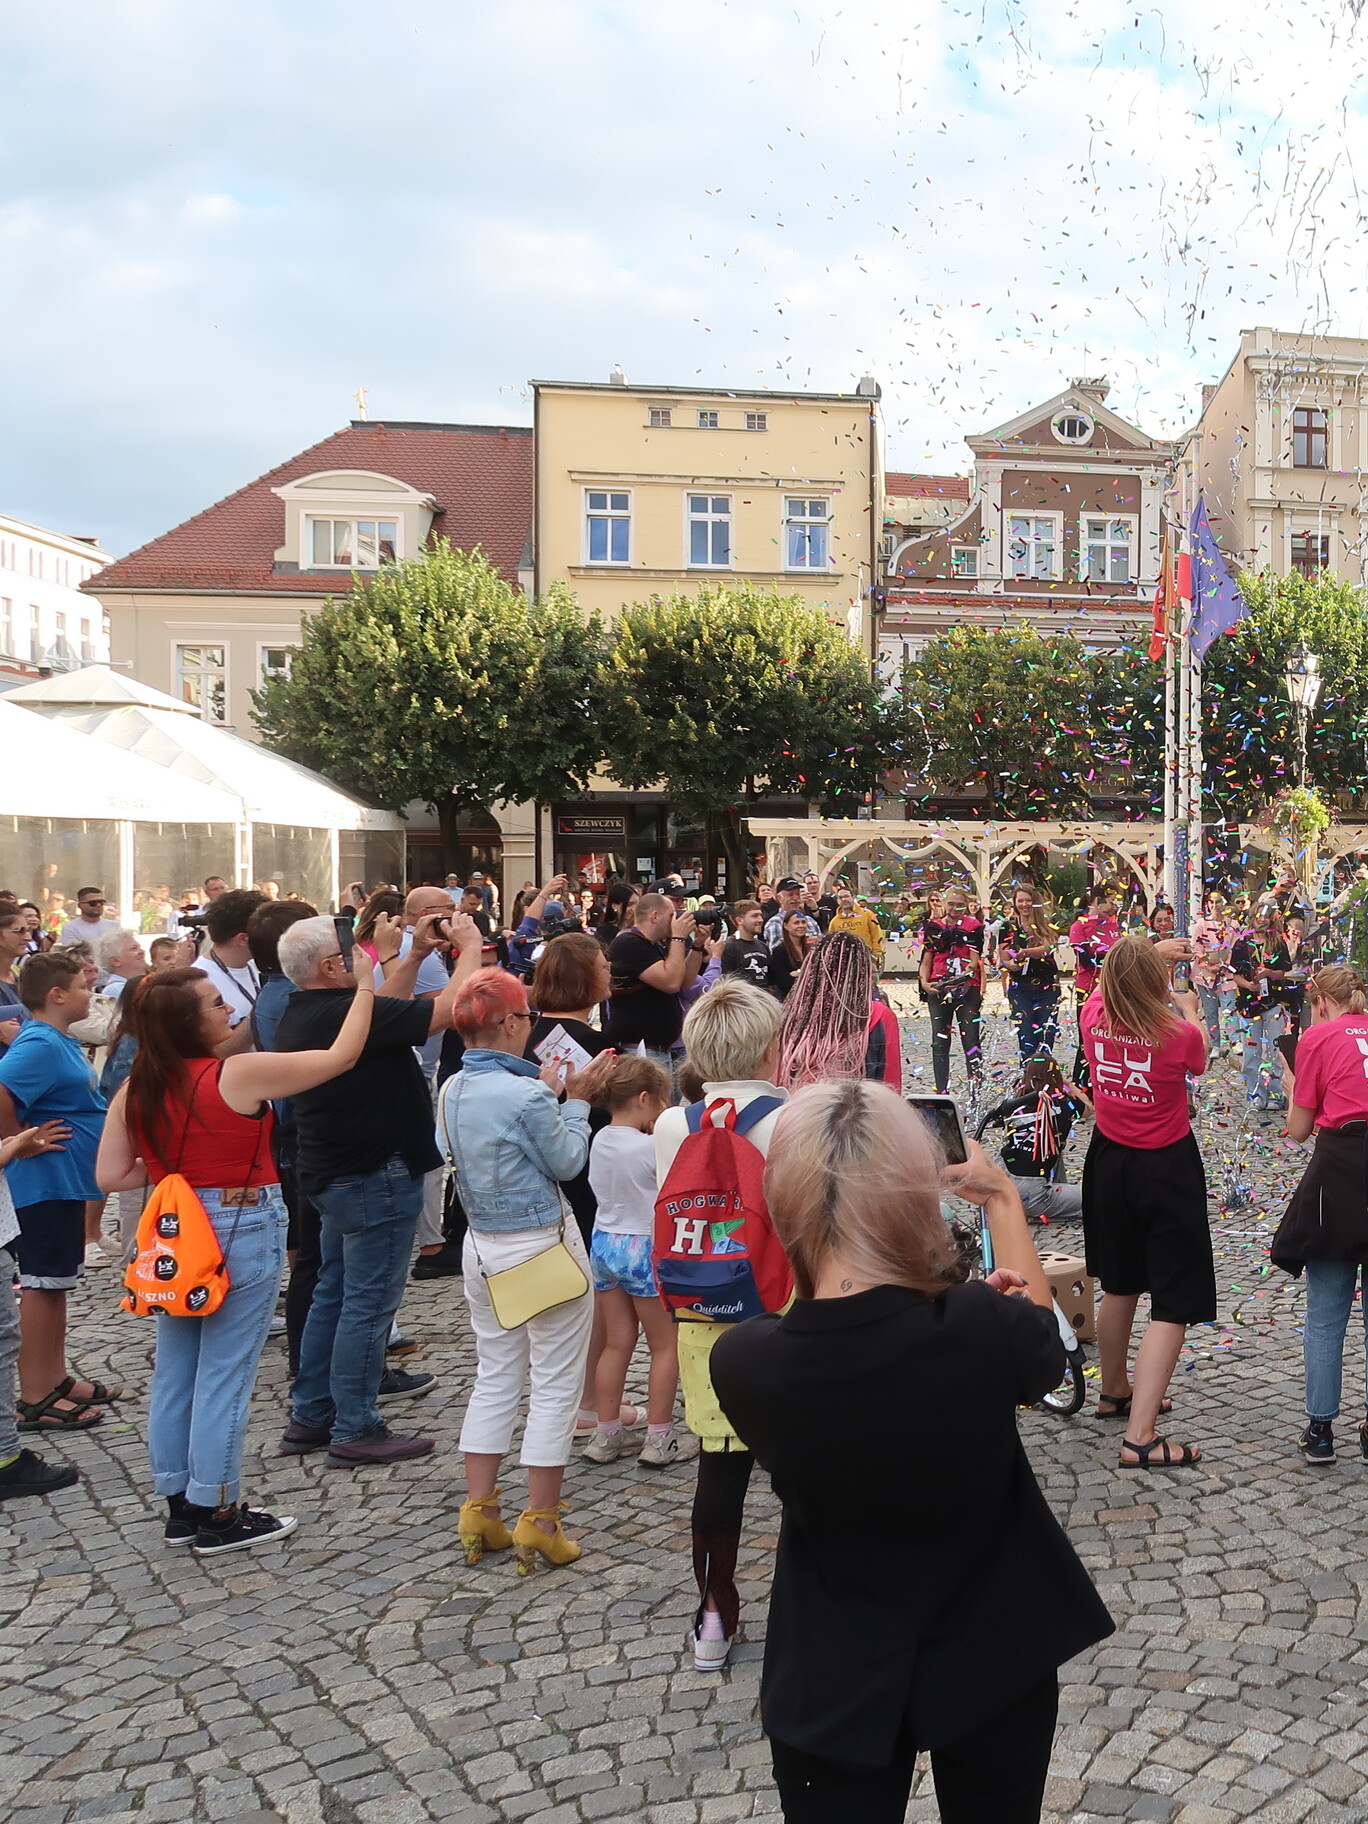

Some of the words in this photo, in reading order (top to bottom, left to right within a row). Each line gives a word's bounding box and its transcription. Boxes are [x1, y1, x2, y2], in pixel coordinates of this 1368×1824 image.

[1091, 1027, 1161, 1047] ORGANIZATO
[1095, 1042, 1152, 1072] LU
[1096, 1064, 1153, 1093] FA
[1098, 1085, 1155, 1103] festiwal
[224, 1190, 255, 1204] Lee
[671, 1217, 708, 1255] H
[137, 1288, 177, 1303] LSZNO
[693, 1300, 743, 1316] Quidditch
